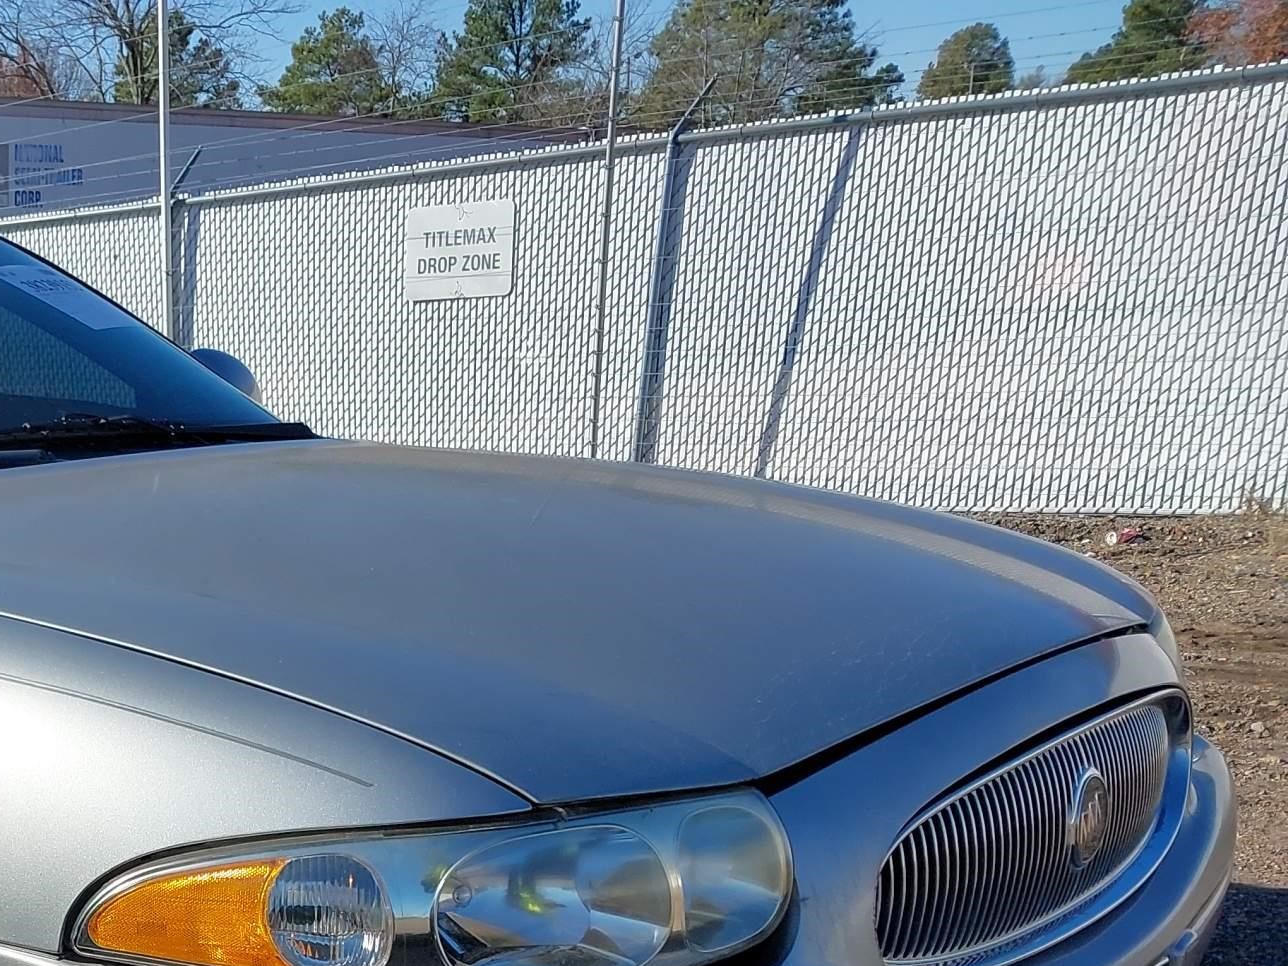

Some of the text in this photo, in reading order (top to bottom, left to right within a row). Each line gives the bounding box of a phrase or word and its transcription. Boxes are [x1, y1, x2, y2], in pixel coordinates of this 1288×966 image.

[423, 226, 497, 248] TITLEMAX
[417, 253, 501, 275] DROP ZONE
